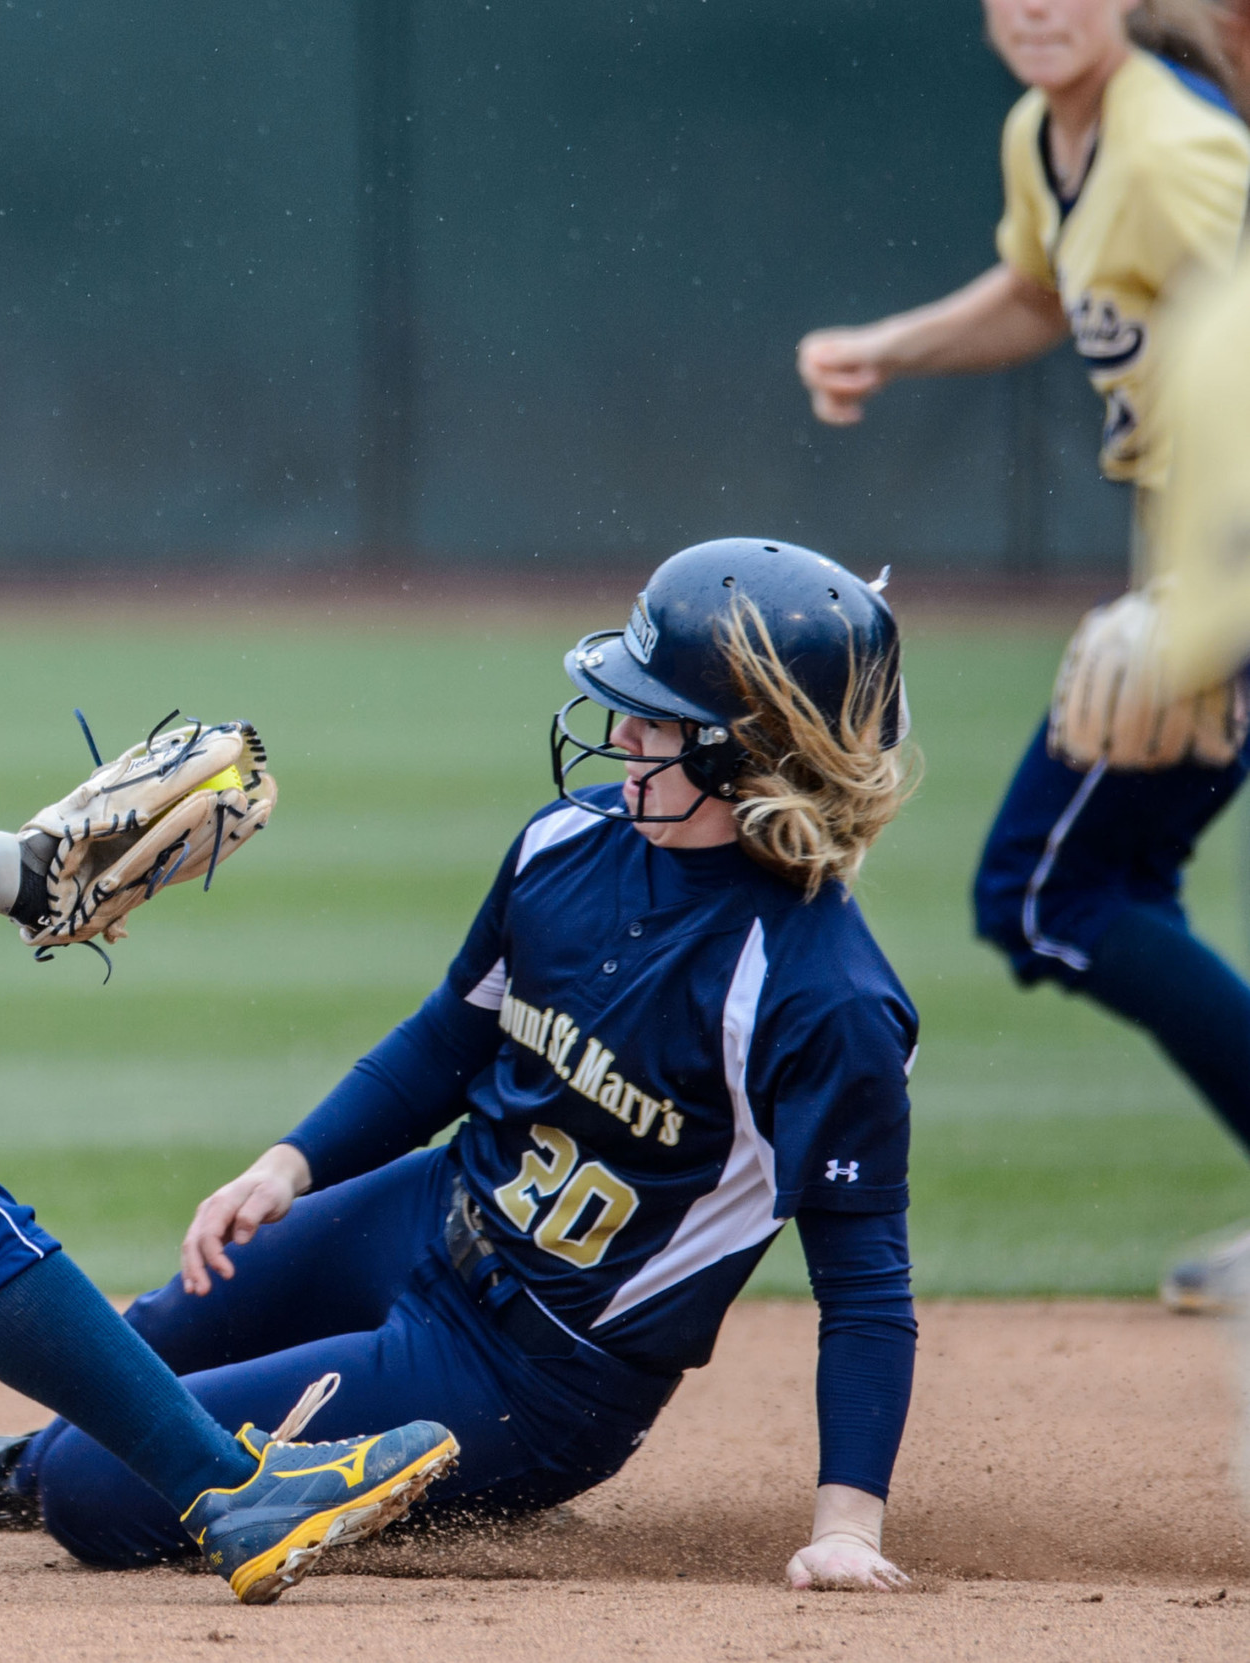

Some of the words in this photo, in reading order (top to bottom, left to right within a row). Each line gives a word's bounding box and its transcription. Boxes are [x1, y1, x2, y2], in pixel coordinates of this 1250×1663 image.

[498, 976, 554, 1056] ount
[547, 1012, 580, 1080] St.
[568, 1036, 685, 1147] Mary's
[493, 1122, 640, 1270] 20
